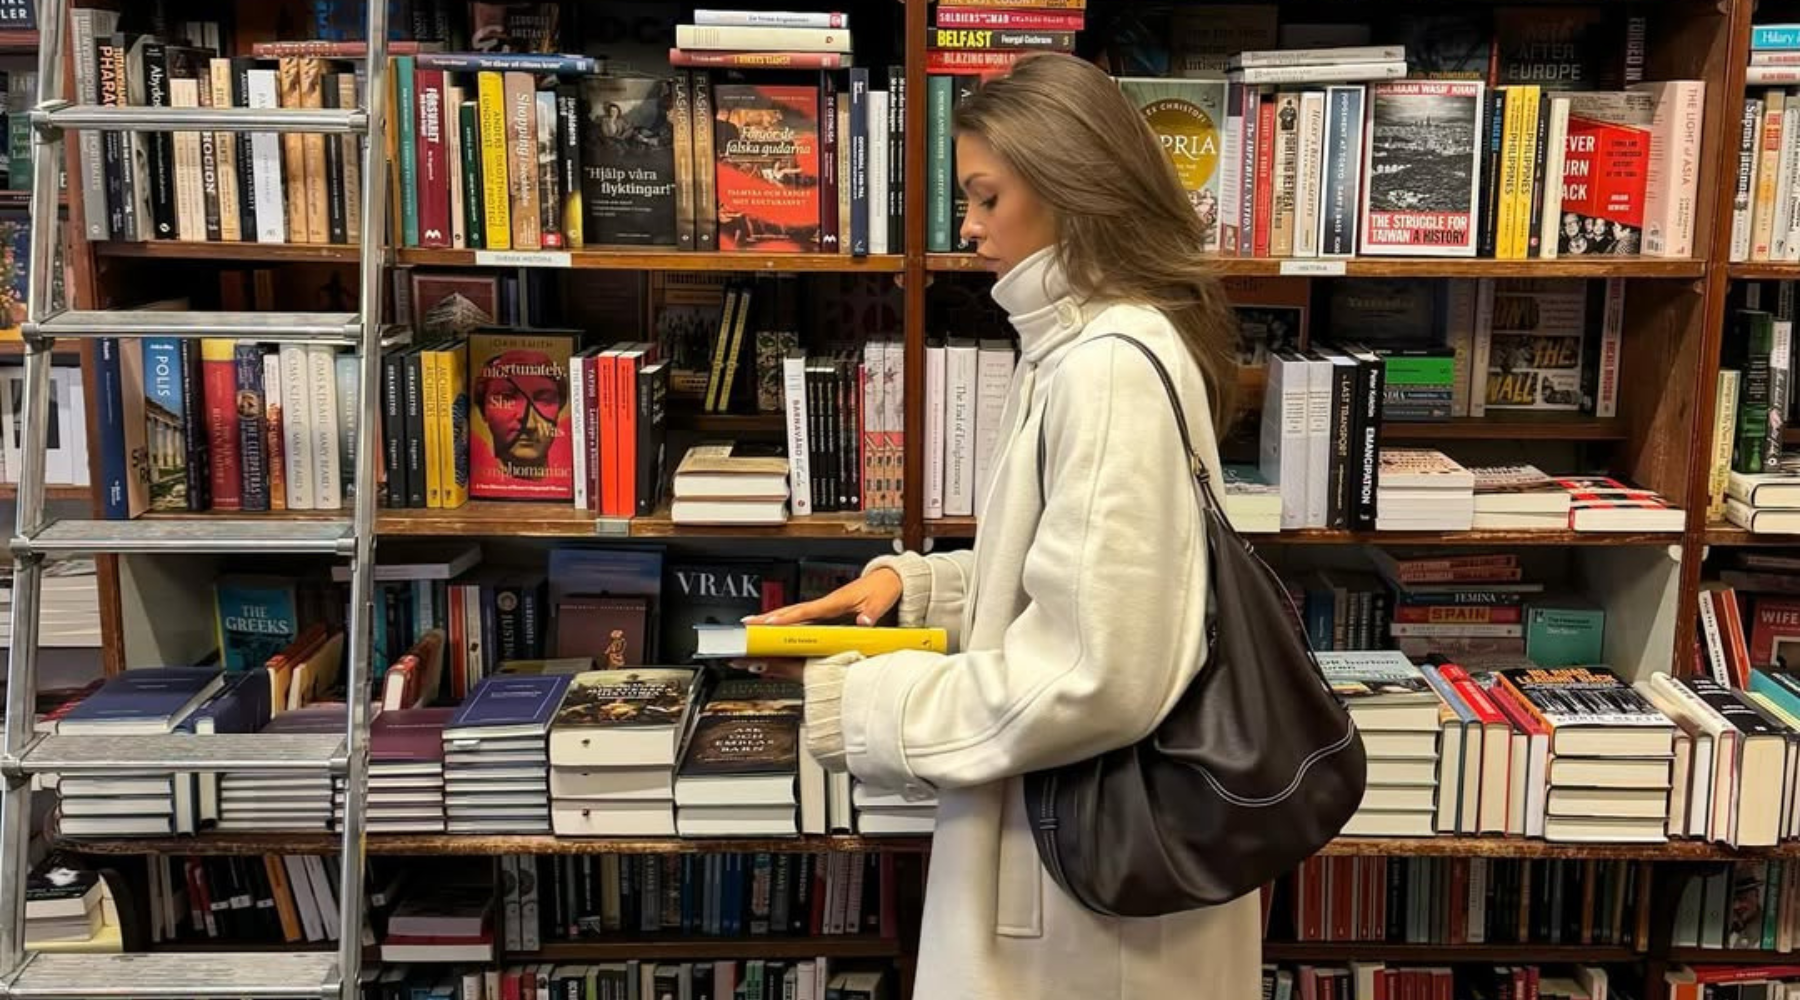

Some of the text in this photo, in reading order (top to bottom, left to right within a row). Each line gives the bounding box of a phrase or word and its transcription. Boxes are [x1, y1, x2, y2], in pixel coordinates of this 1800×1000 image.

[1, 8, 28, 19] LER
[938, 30, 992, 47] BELFAST
[945, 53, 983, 64] BLAZING
[1509, 63, 1582, 80] EUROPE
[1688, 88, 1697, 109] THE
[514, 93, 531, 157] Shopping
[1685, 112, 1696, 145] LIGHT
[1742, 104, 1757, 149] Sápmis
[725, 140, 811, 157] falska gudarna
[1160, 134, 1217, 161] PRIA
[1562, 136, 1596, 152] EVER
[202, 131, 216, 192] HOCION
[1284, 132, 1297, 174] FIGHTING
[1245, 140, 1255, 191] IMPERIAL
[1504, 132, 1518, 196] PHILIPPINES
[1520, 132, 1535, 196] PHILIPPINES
[1561, 160, 1590, 177] URN
[628, 168, 657, 181] våra
[1682, 159, 1693, 187] ASIA
[1282, 175, 1295, 214] RETREAT
[1560, 184, 1588, 200] ACK
[1371, 214, 1467, 229] THE STRUGGLE FOR
[1372, 229, 1410, 243] TAIWAN
[1423, 230, 1466, 244] HISTORY
[156, 355, 172, 397] POLIS
[490, 394, 516, 410] She
[956, 385, 968, 402] The
[956, 404, 966, 421] End
[1361, 427, 1375, 504] EMANCIPATION
[674, 571, 761, 598] VRAK
[242, 605, 267, 618] THE
[1762, 610, 1799, 625] WIFE
[226, 616, 289, 634] GREEKS
